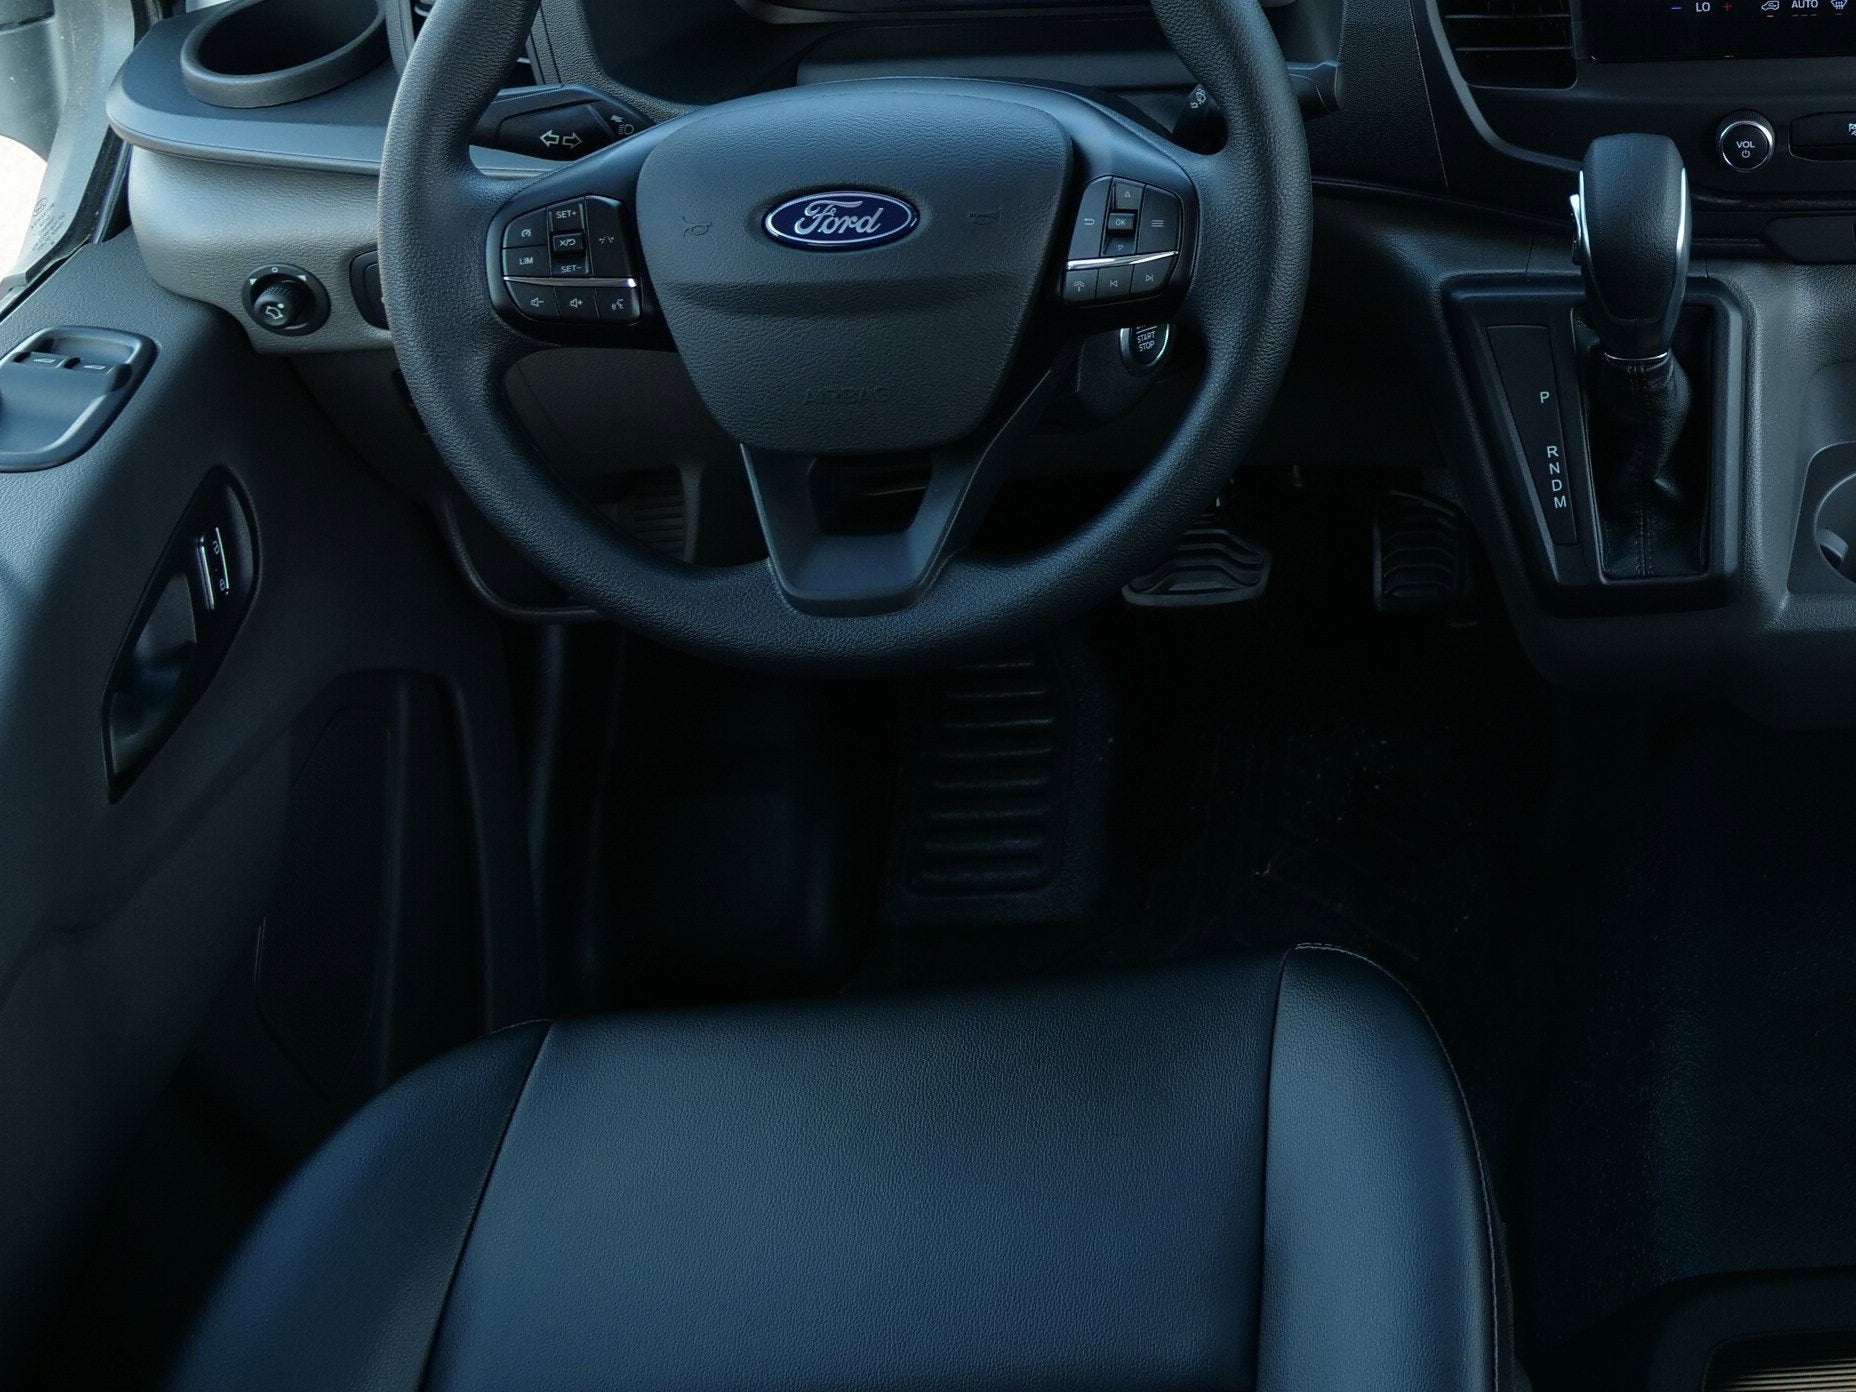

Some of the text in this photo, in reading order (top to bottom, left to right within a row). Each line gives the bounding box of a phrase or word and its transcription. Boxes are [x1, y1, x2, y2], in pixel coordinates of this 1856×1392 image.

[1695, 1, 1711, 12] LO
[1791, 0, 1818, 9] AUTO
[1736, 140, 1756, 149] VOL
[794, 199, 884, 235] Ford
[1115, 219, 1126, 227] OK
[519, 257, 534, 266] LIM
[1137, 330, 1156, 344] START
[1139, 339, 1155, 352] STOP
[1540, 391, 1550, 404] P
[1546, 445, 1559, 458] R
[1549, 462, 1560, 475] N
[1551, 479, 1562, 491] D
[1554, 495, 1567, 508] M
